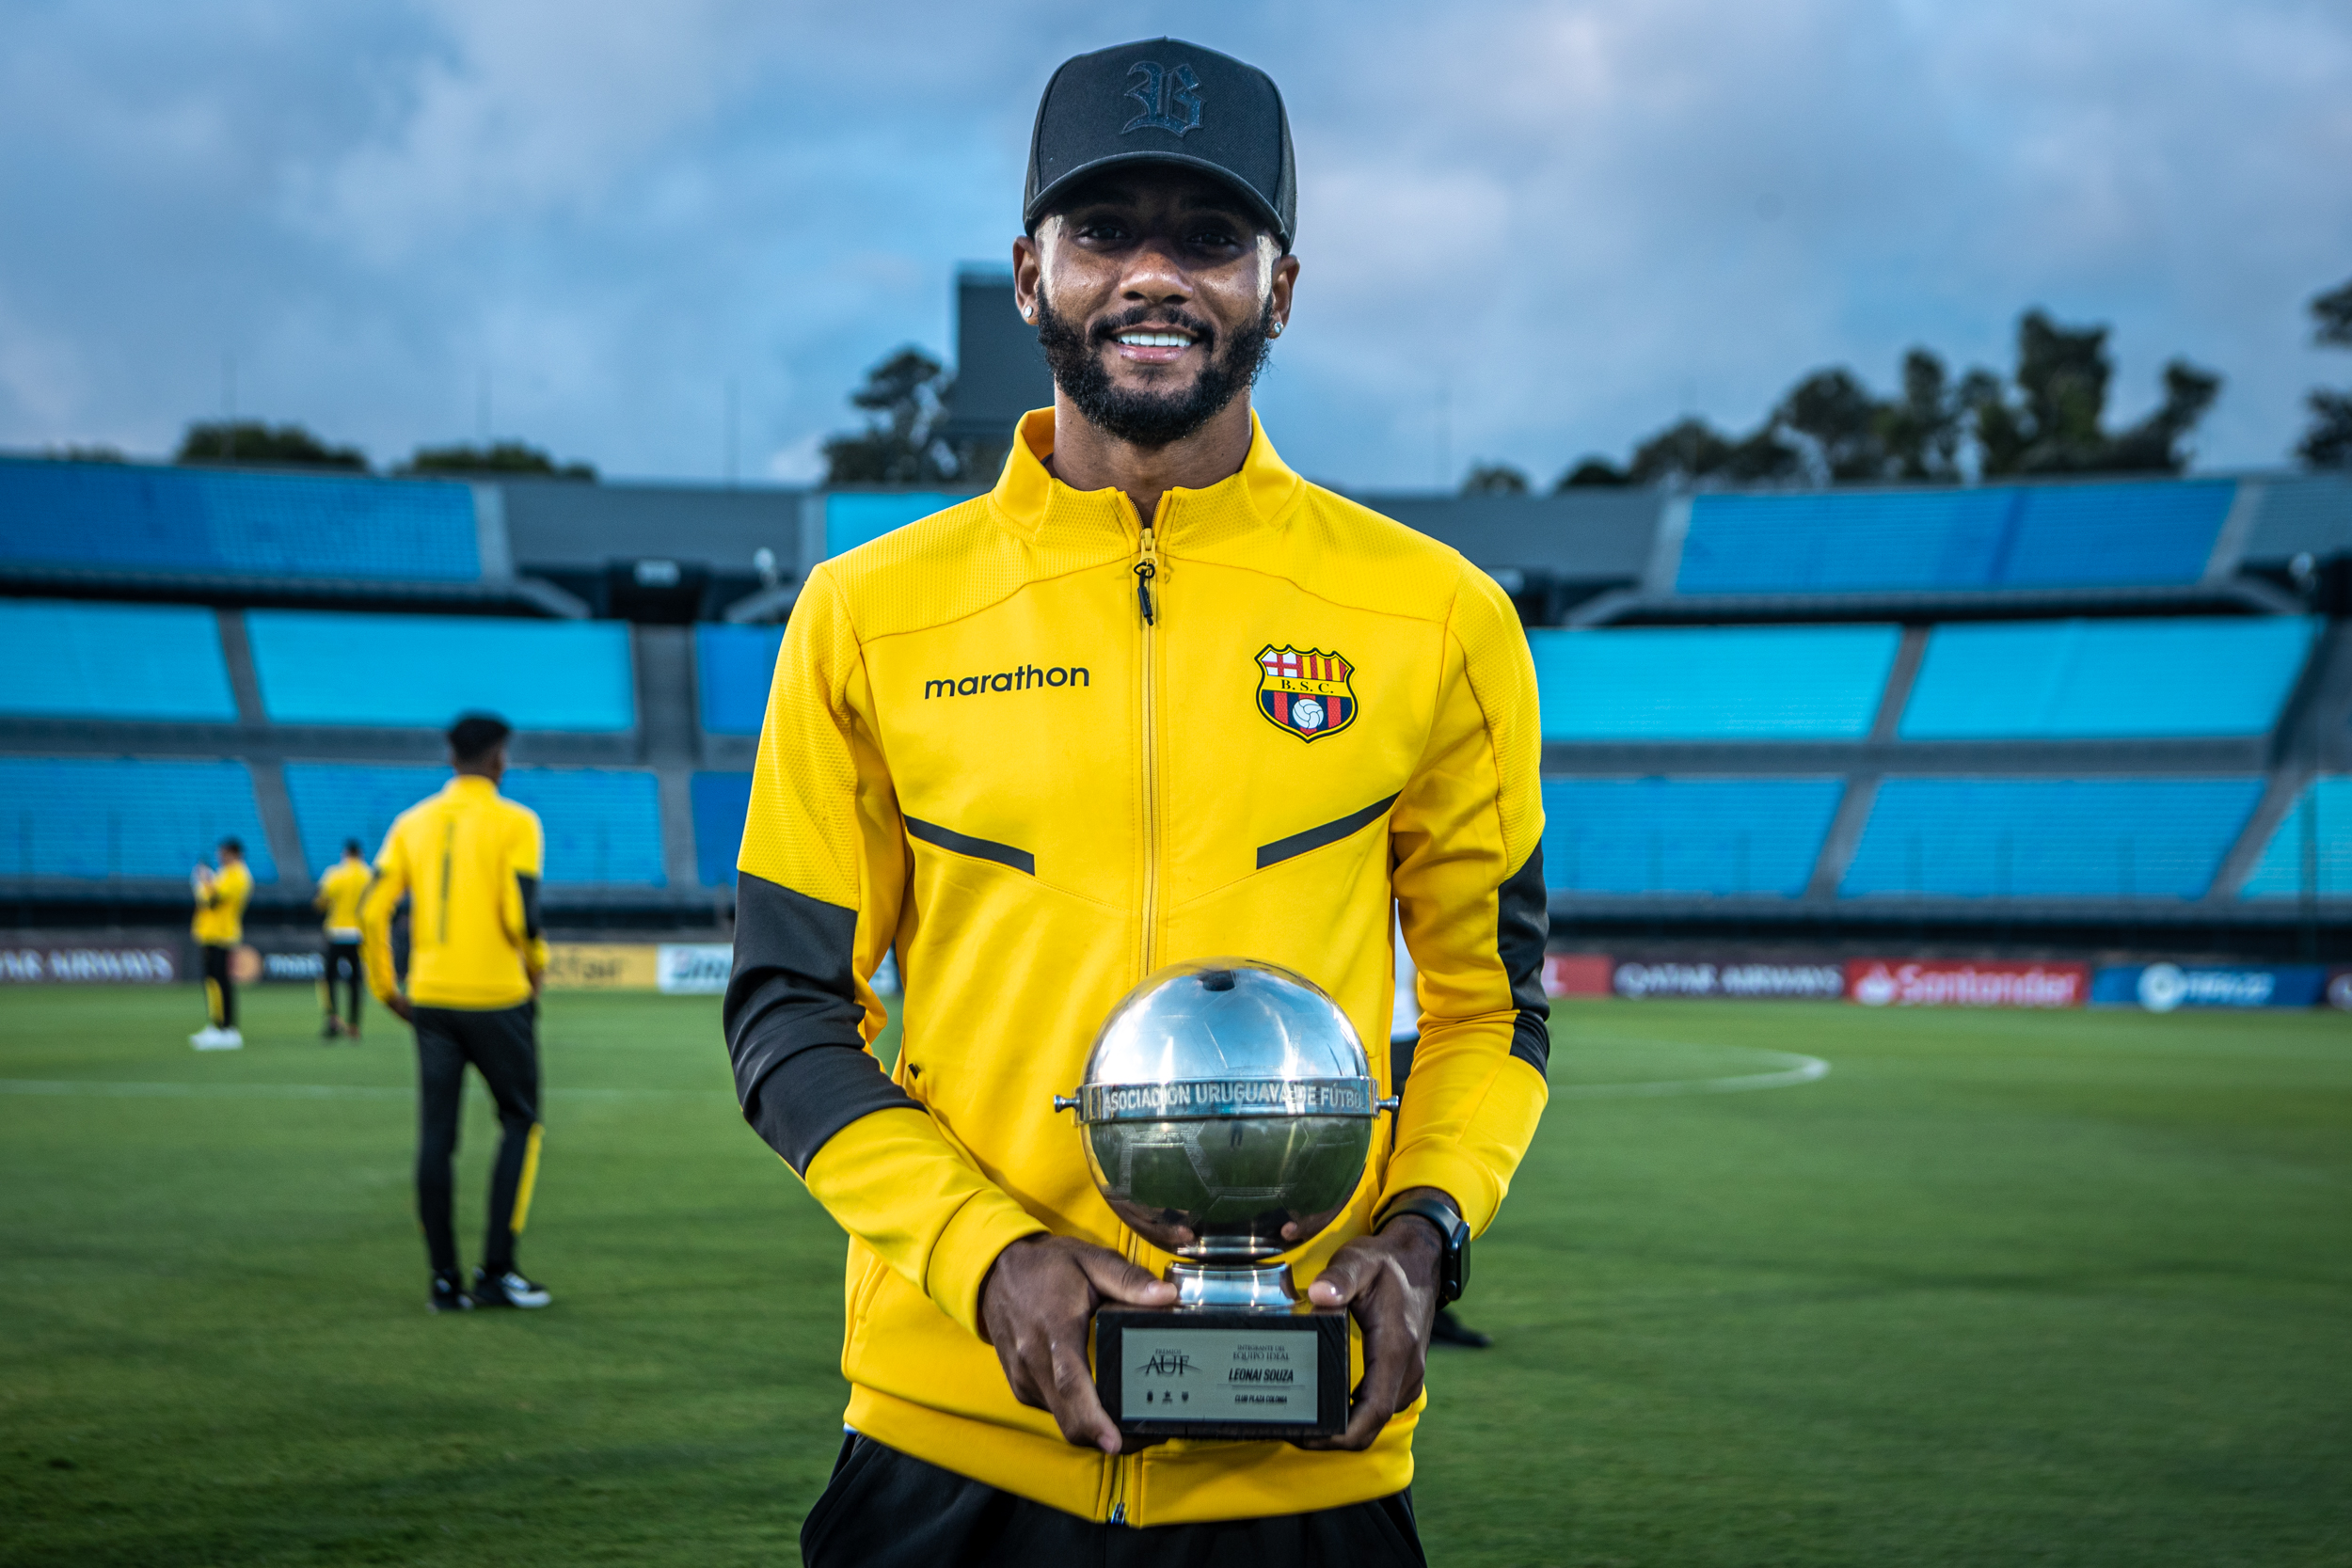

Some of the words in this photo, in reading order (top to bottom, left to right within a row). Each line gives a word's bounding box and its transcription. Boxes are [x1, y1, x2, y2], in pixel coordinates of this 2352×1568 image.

[1120, 60, 1207, 138] B
[924, 663, 1089, 700] marathon
[1897, 964, 2081, 1007] Santander
[1195, 1081, 1291, 1104] URUGUAYA
[1293, 1085, 1317, 1106] DE
[1145, 1354, 1190, 1376] AUF
[1232, 1351, 1264, 1361] EQUIPO
[1266, 1352, 1290, 1361] IDEAL
[1229, 1368, 1263, 1383] LEONAI
[1263, 1369, 1294, 1384] SOUZA
[1234, 1394, 1248, 1402] CLUB
[1249, 1394, 1265, 1403] PLAZA
[1265, 1395, 1288, 1404] COLONIA
